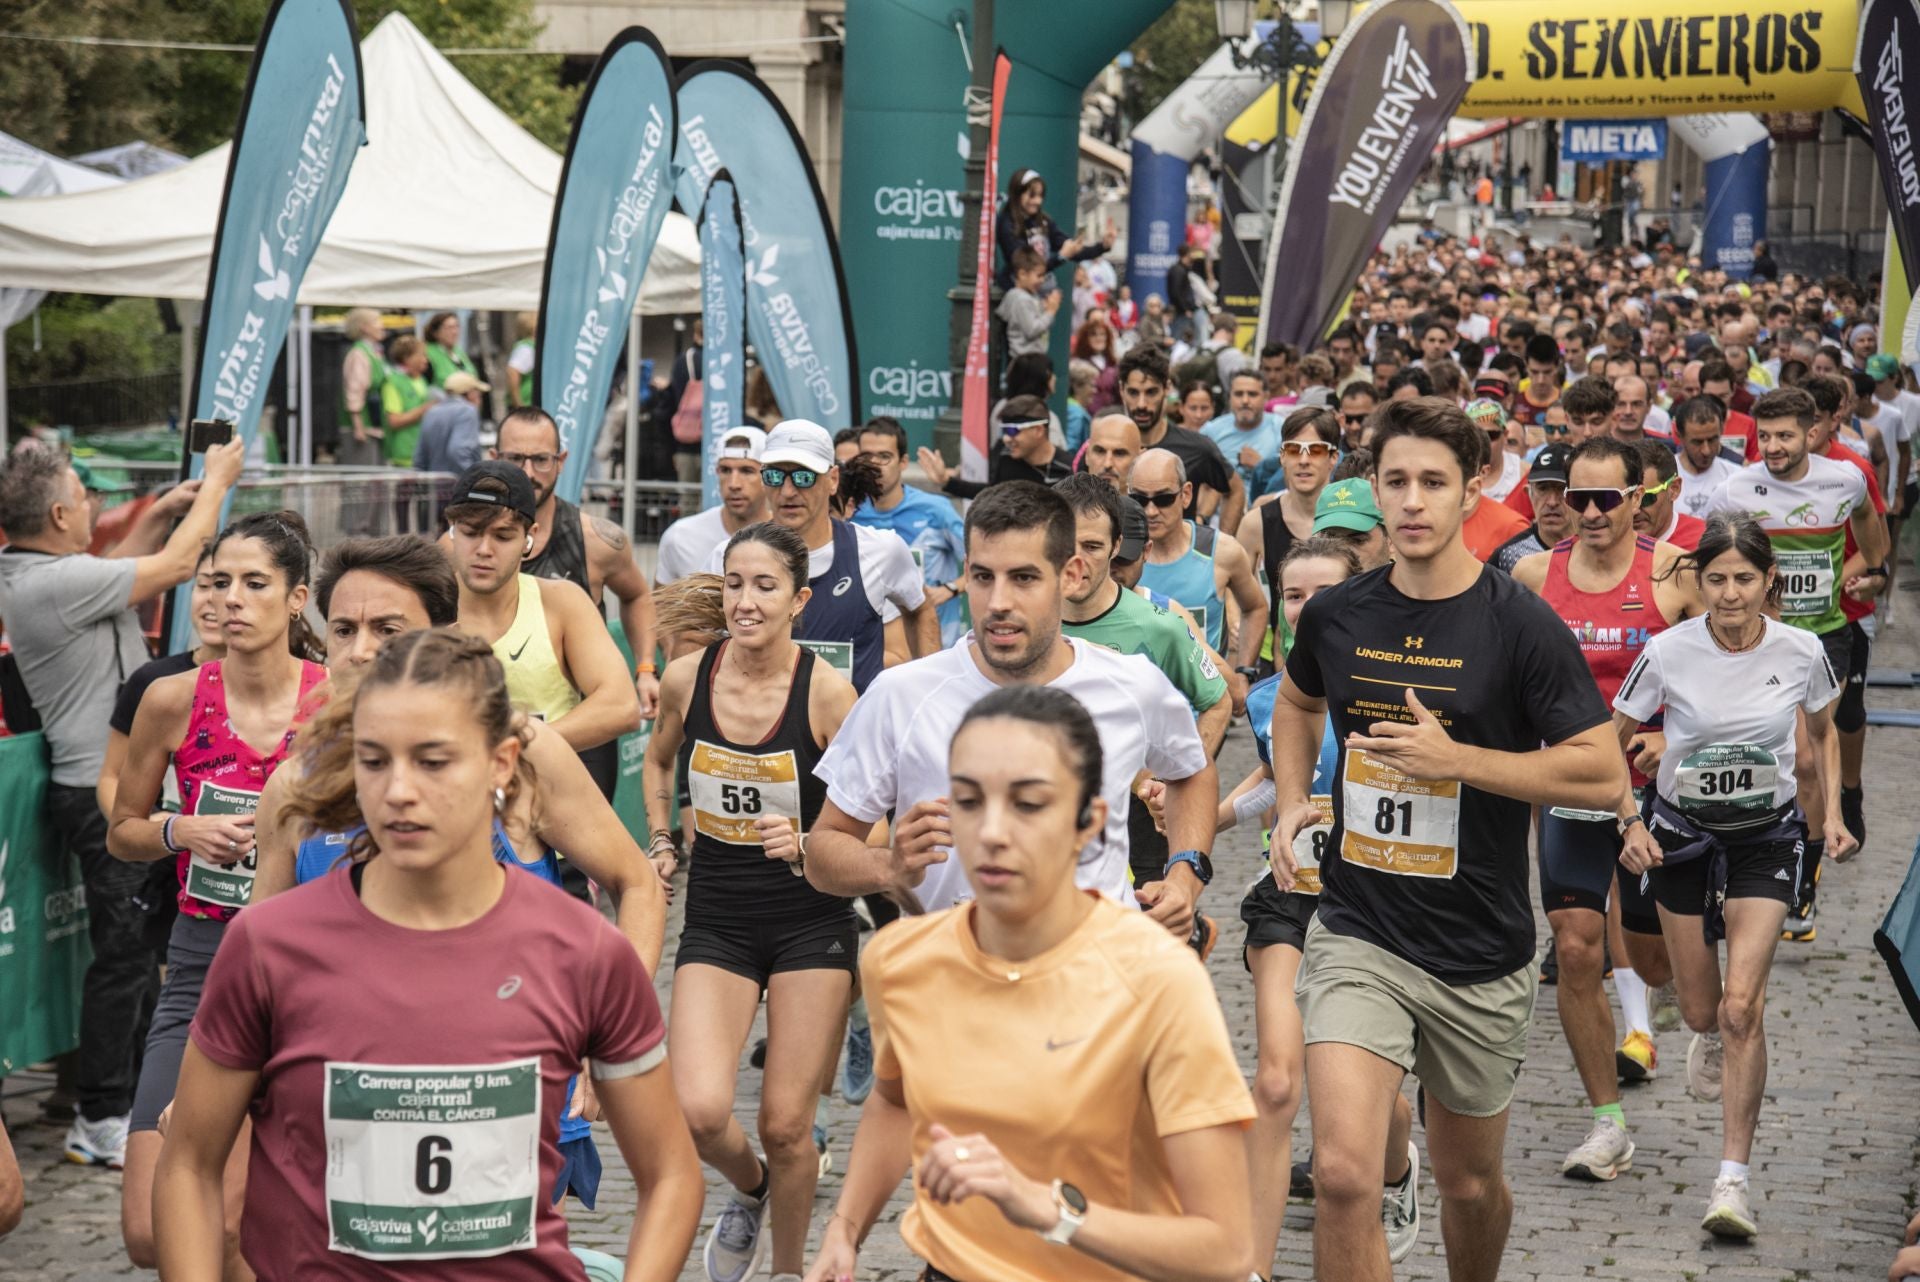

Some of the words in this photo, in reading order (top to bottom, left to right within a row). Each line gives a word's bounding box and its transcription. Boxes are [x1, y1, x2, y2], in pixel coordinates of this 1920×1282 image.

[1525, 11, 1822, 85] SEXMEROS
[1547, 96, 1562, 107] de
[1567, 95, 1581, 106] la
[1584, 94, 1634, 106] Ciudad
[1651, 93, 1693, 105] Tierra
[1697, 92, 1714, 104] de
[1719, 90, 1775, 103] Segovia
[1570, 126, 1658, 153] META
[1328, 152, 1380, 208] YOU
[874, 179, 965, 225] cajav
[1717, 249, 1755, 264] SEGOV
[869, 359, 953, 406] cajav
[1355, 647, 1403, 663] UNDER
[1404, 655, 1463, 668] ARMOUR
[1347, 707, 1361, 715] BUILT
[1371, 710, 1387, 719] MAKE
[1355, 700, 1392, 711] ORIGINATORS
[1393, 704, 1401, 712] OF
[1717, 746, 1743, 755] popular
[215, 763, 239, 777] SPORT
[710, 768, 735, 780] CONTRA
[1365, 778, 1390, 789] CONTRA
[1699, 768, 1754, 796] 304
[213, 790, 245, 807] Carrera
[721, 783, 762, 814] 53
[1375, 796, 1413, 837] 81
[1396, 851, 1441, 862] cajarural
[201, 875, 236, 892] cajaviva
[358, 1073, 412, 1089] Carrera
[415, 1075, 472, 1093] popular
[474, 1074, 485, 1089] 9
[487, 1074, 512, 1087] km.
[398, 1091, 472, 1109] cajarural
[373, 1108, 425, 1121] CONTRA
[427, 1109, 442, 1121] EL
[445, 1107, 496, 1122] CÁNCER
[415, 1135, 453, 1195] 6
[350, 1216, 412, 1236] cajaviva
[441, 1212, 512, 1233] cajarural
